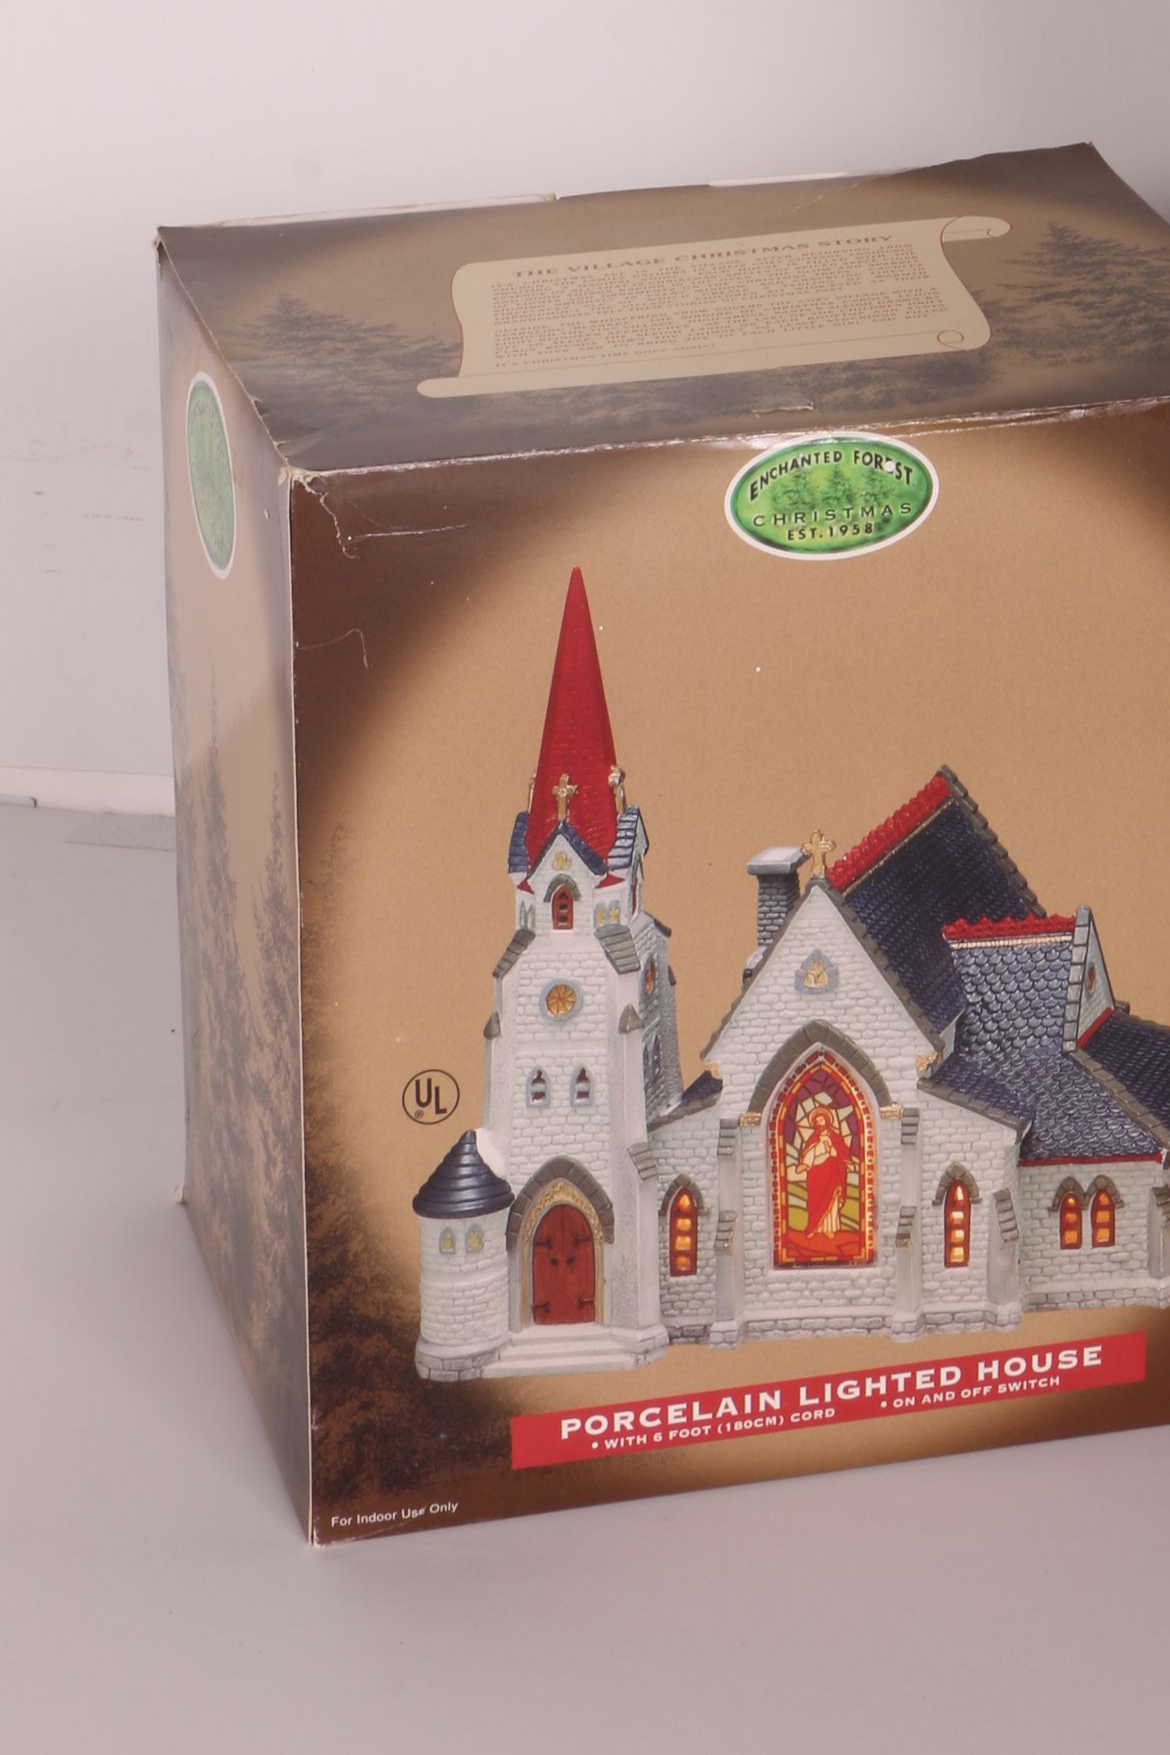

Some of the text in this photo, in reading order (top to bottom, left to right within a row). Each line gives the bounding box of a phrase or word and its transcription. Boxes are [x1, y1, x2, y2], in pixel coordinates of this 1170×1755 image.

[749, 450, 843, 502] ENCHANTED
[753, 502, 913, 528] CHRISTMAS
[561, 1345, 1103, 1440] PORCELAIN LIGHTED HOUSE
[892, 1375, 1060, 1409] ON AND OFF SWITCH
[604, 1407, 836, 1450] WITH 6 FOOT (180CM) CORD
[331, 1501, 459, 1528] For Indoor Use Only
